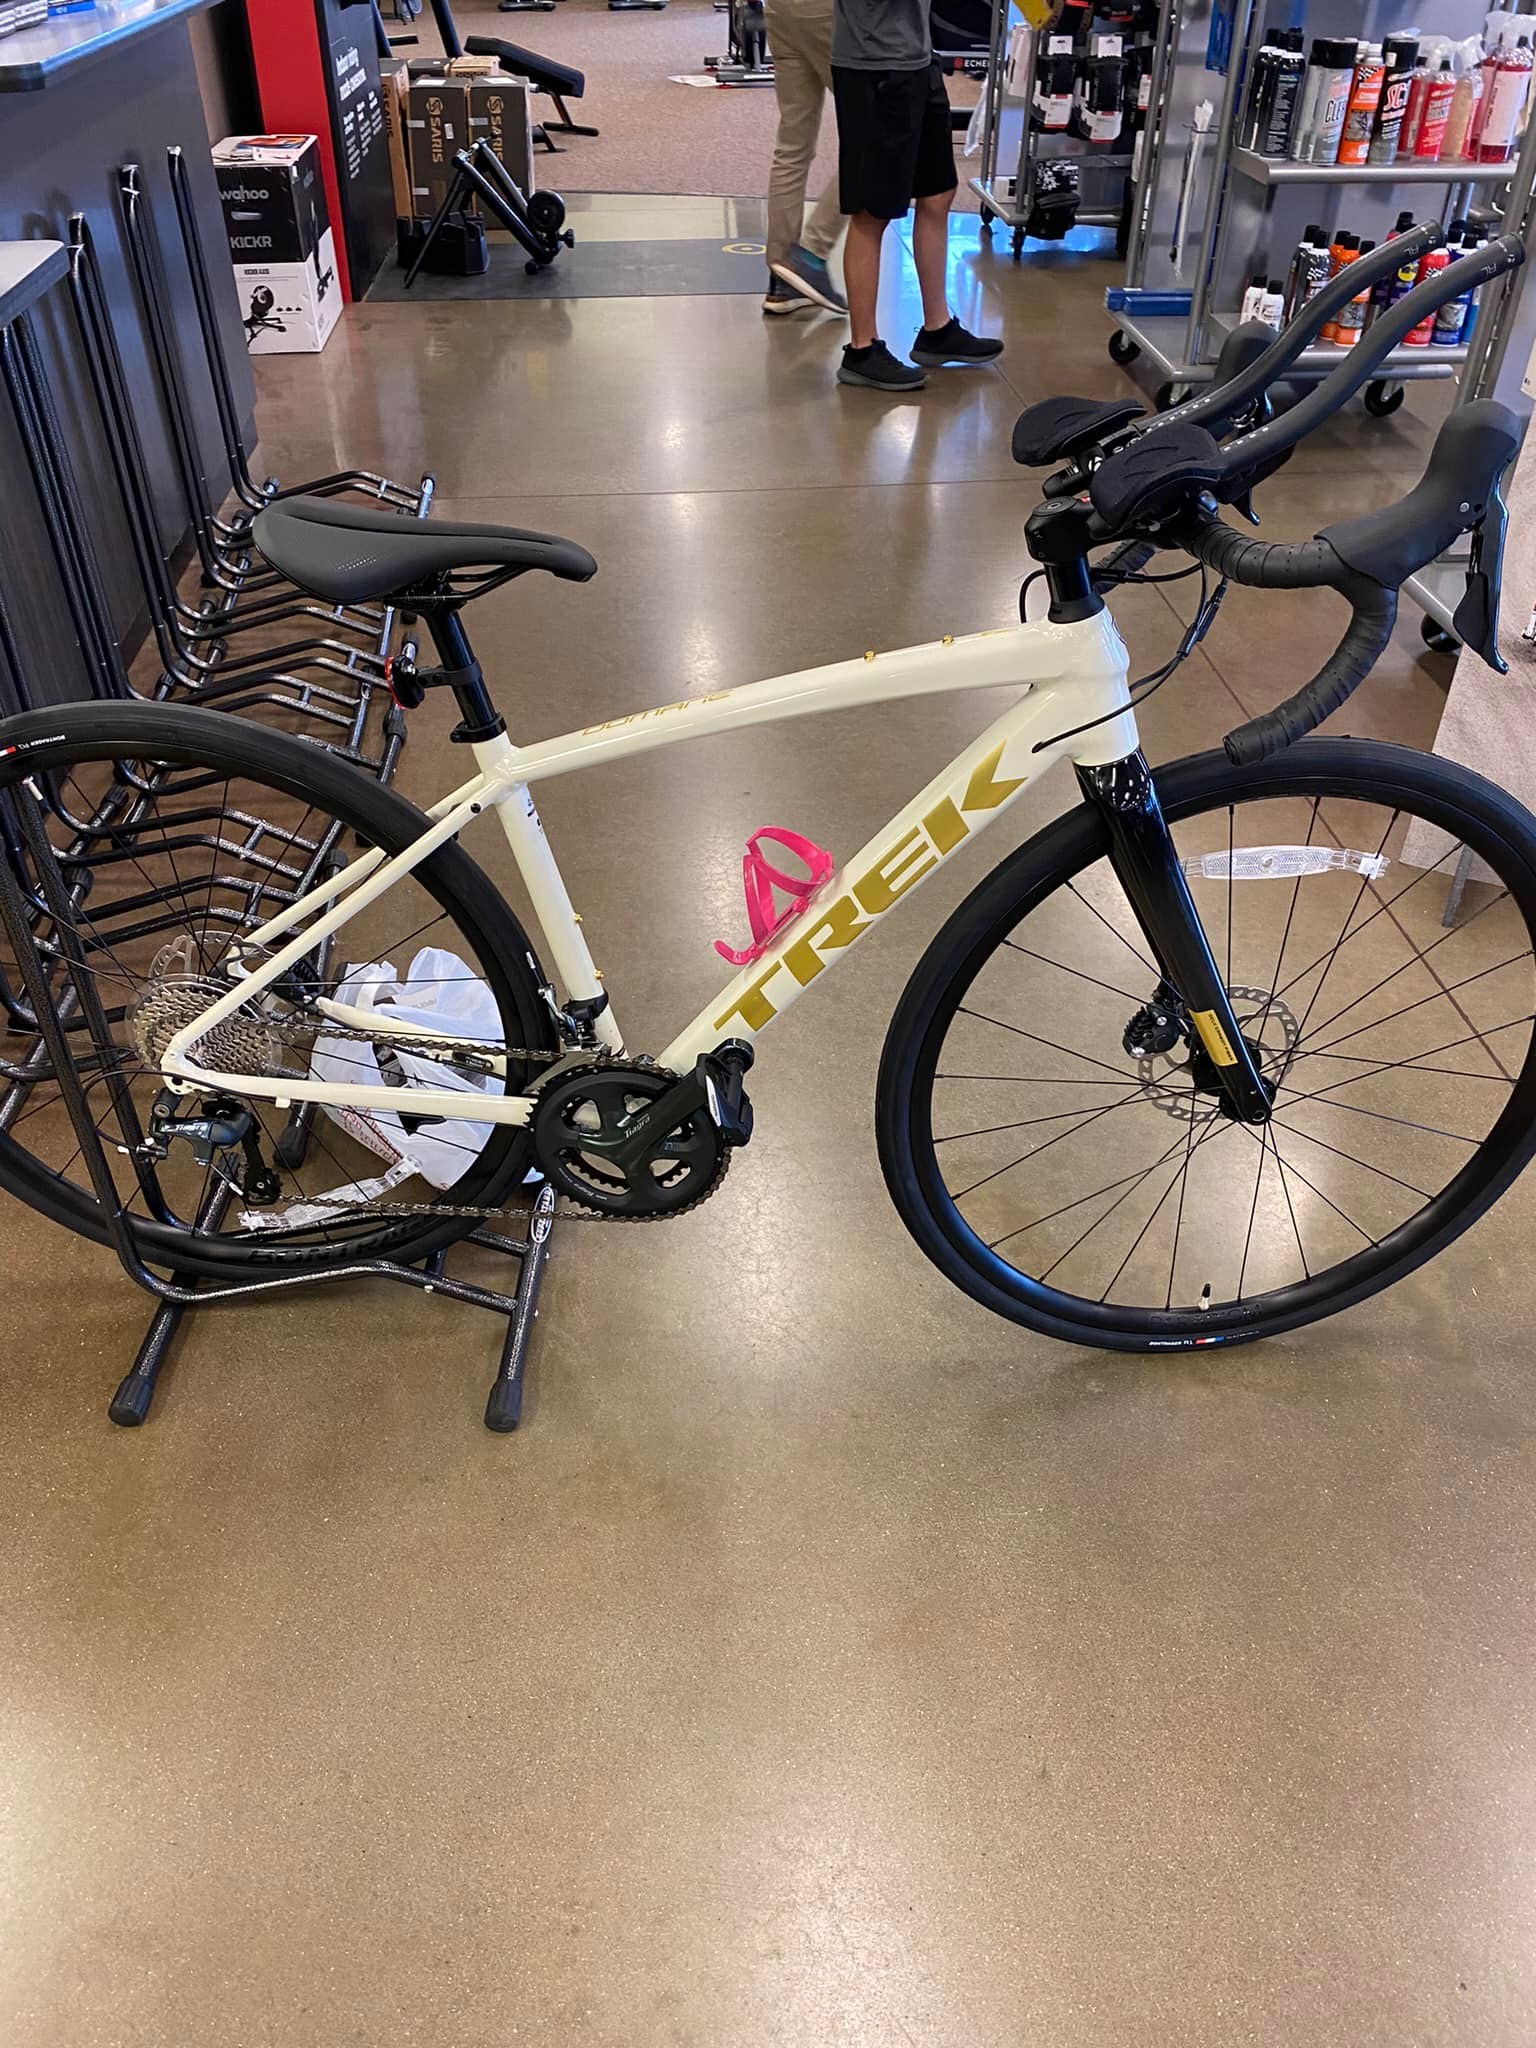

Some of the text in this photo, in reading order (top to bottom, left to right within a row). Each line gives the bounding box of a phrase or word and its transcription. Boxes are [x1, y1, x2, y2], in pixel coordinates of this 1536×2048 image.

[964, 59, 990, 68] ECHE
[430, 115, 444, 163] SARIS
[219, 185, 270, 200] wahoo
[229, 236, 273, 249] KICKR
[714, 740, 1029, 1032] TREK
[624, 1115, 652, 1139] Tiagra
